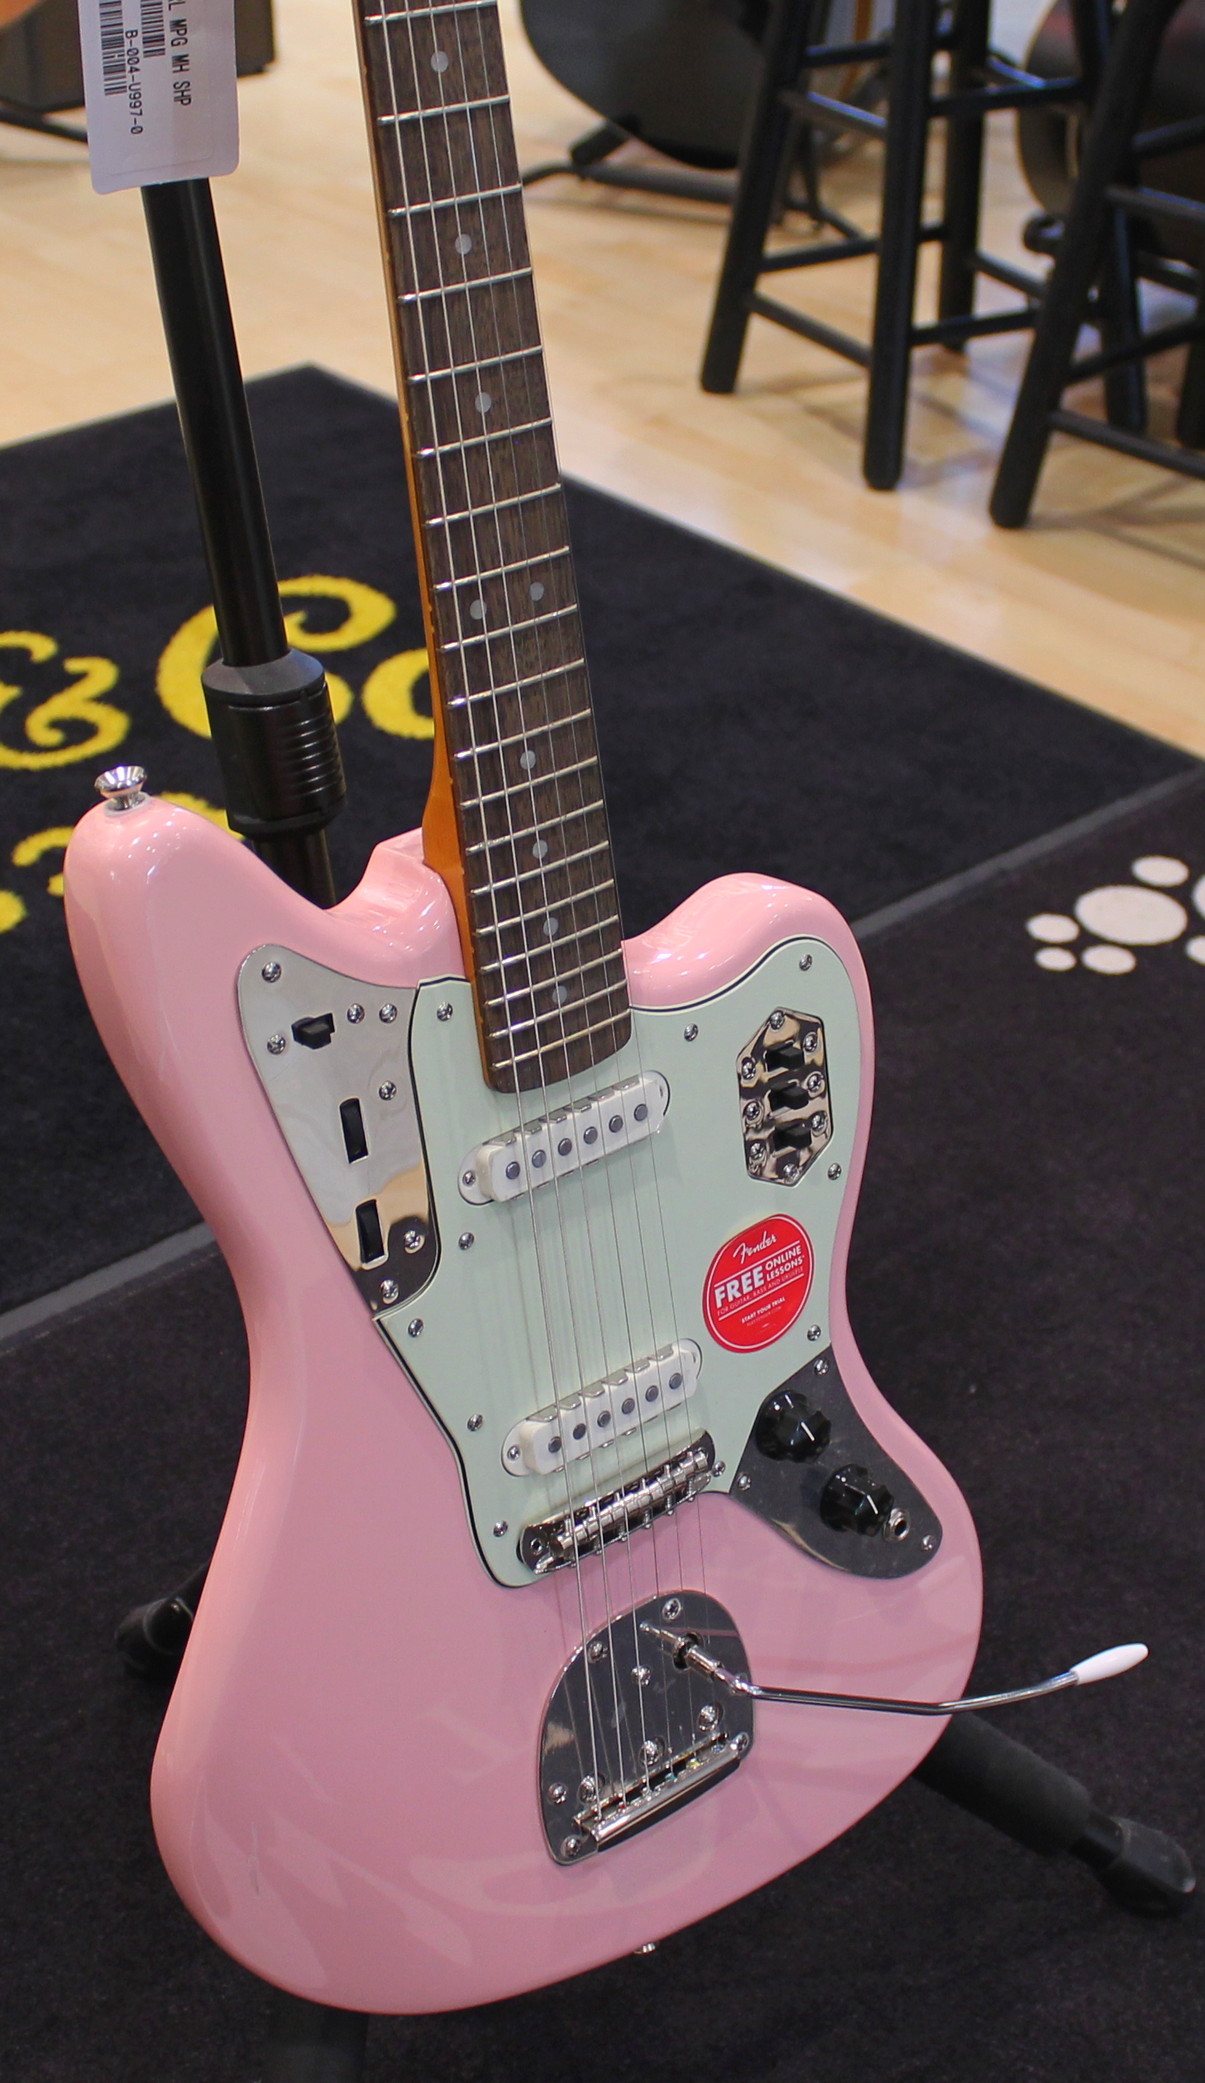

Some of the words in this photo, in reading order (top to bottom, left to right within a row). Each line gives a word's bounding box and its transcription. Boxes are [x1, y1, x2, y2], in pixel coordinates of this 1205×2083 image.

[169, 18, 188, 47] MPG
[172, 53, 190, 74] MH
[173, 81, 191, 106] SHP
[732, 1230, 777, 1264] Fender
[714, 1265, 764, 1309] FREE
[765, 1245, 802, 1271] ONLINE
